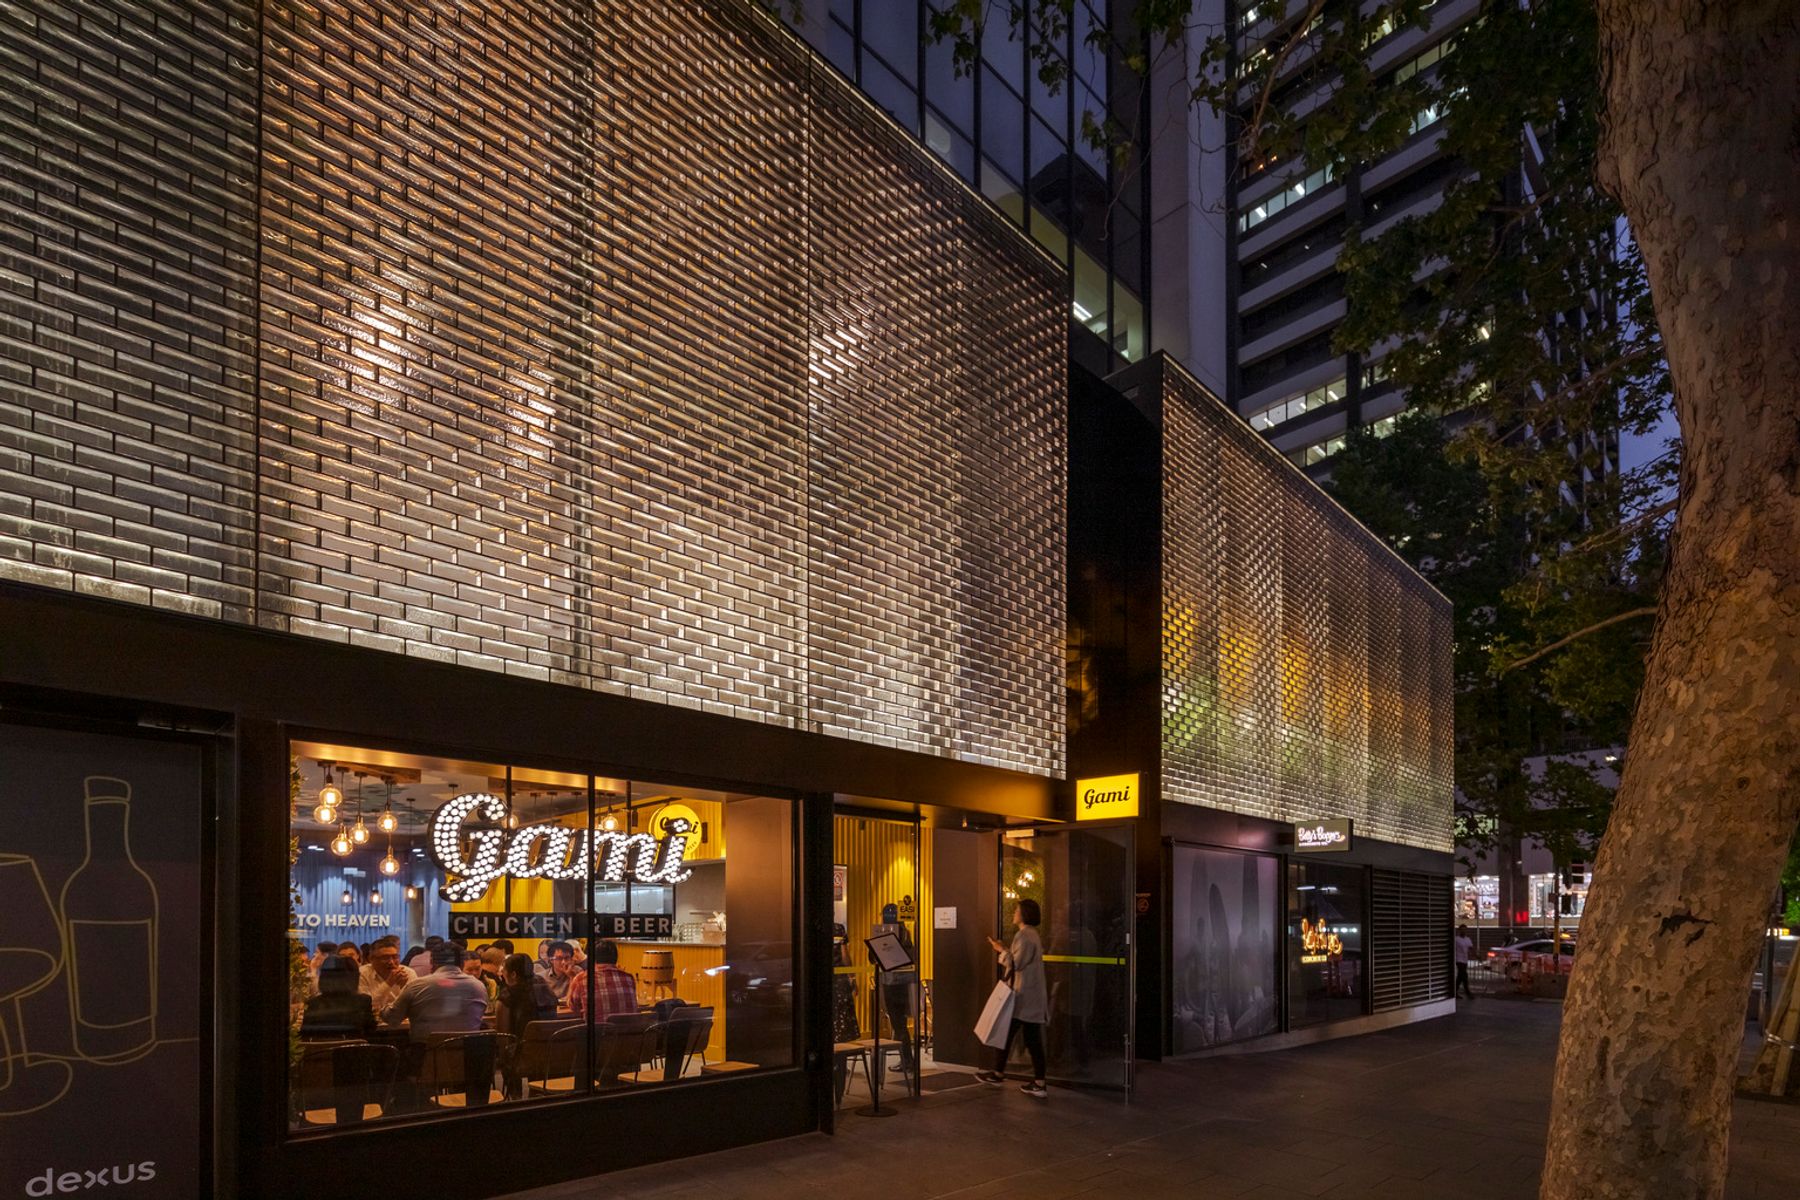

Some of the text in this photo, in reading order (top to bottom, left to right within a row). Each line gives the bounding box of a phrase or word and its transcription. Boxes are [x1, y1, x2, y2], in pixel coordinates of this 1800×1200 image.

[1084, 785, 1130, 809] Gami
[429, 792, 694, 903] Gami
[297, 914, 391, 927] TO HEAVEN
[453, 916, 574, 935] CHICKEN
[614, 917, 670, 934] BEER
[25, 1161, 156, 1197] dexus
